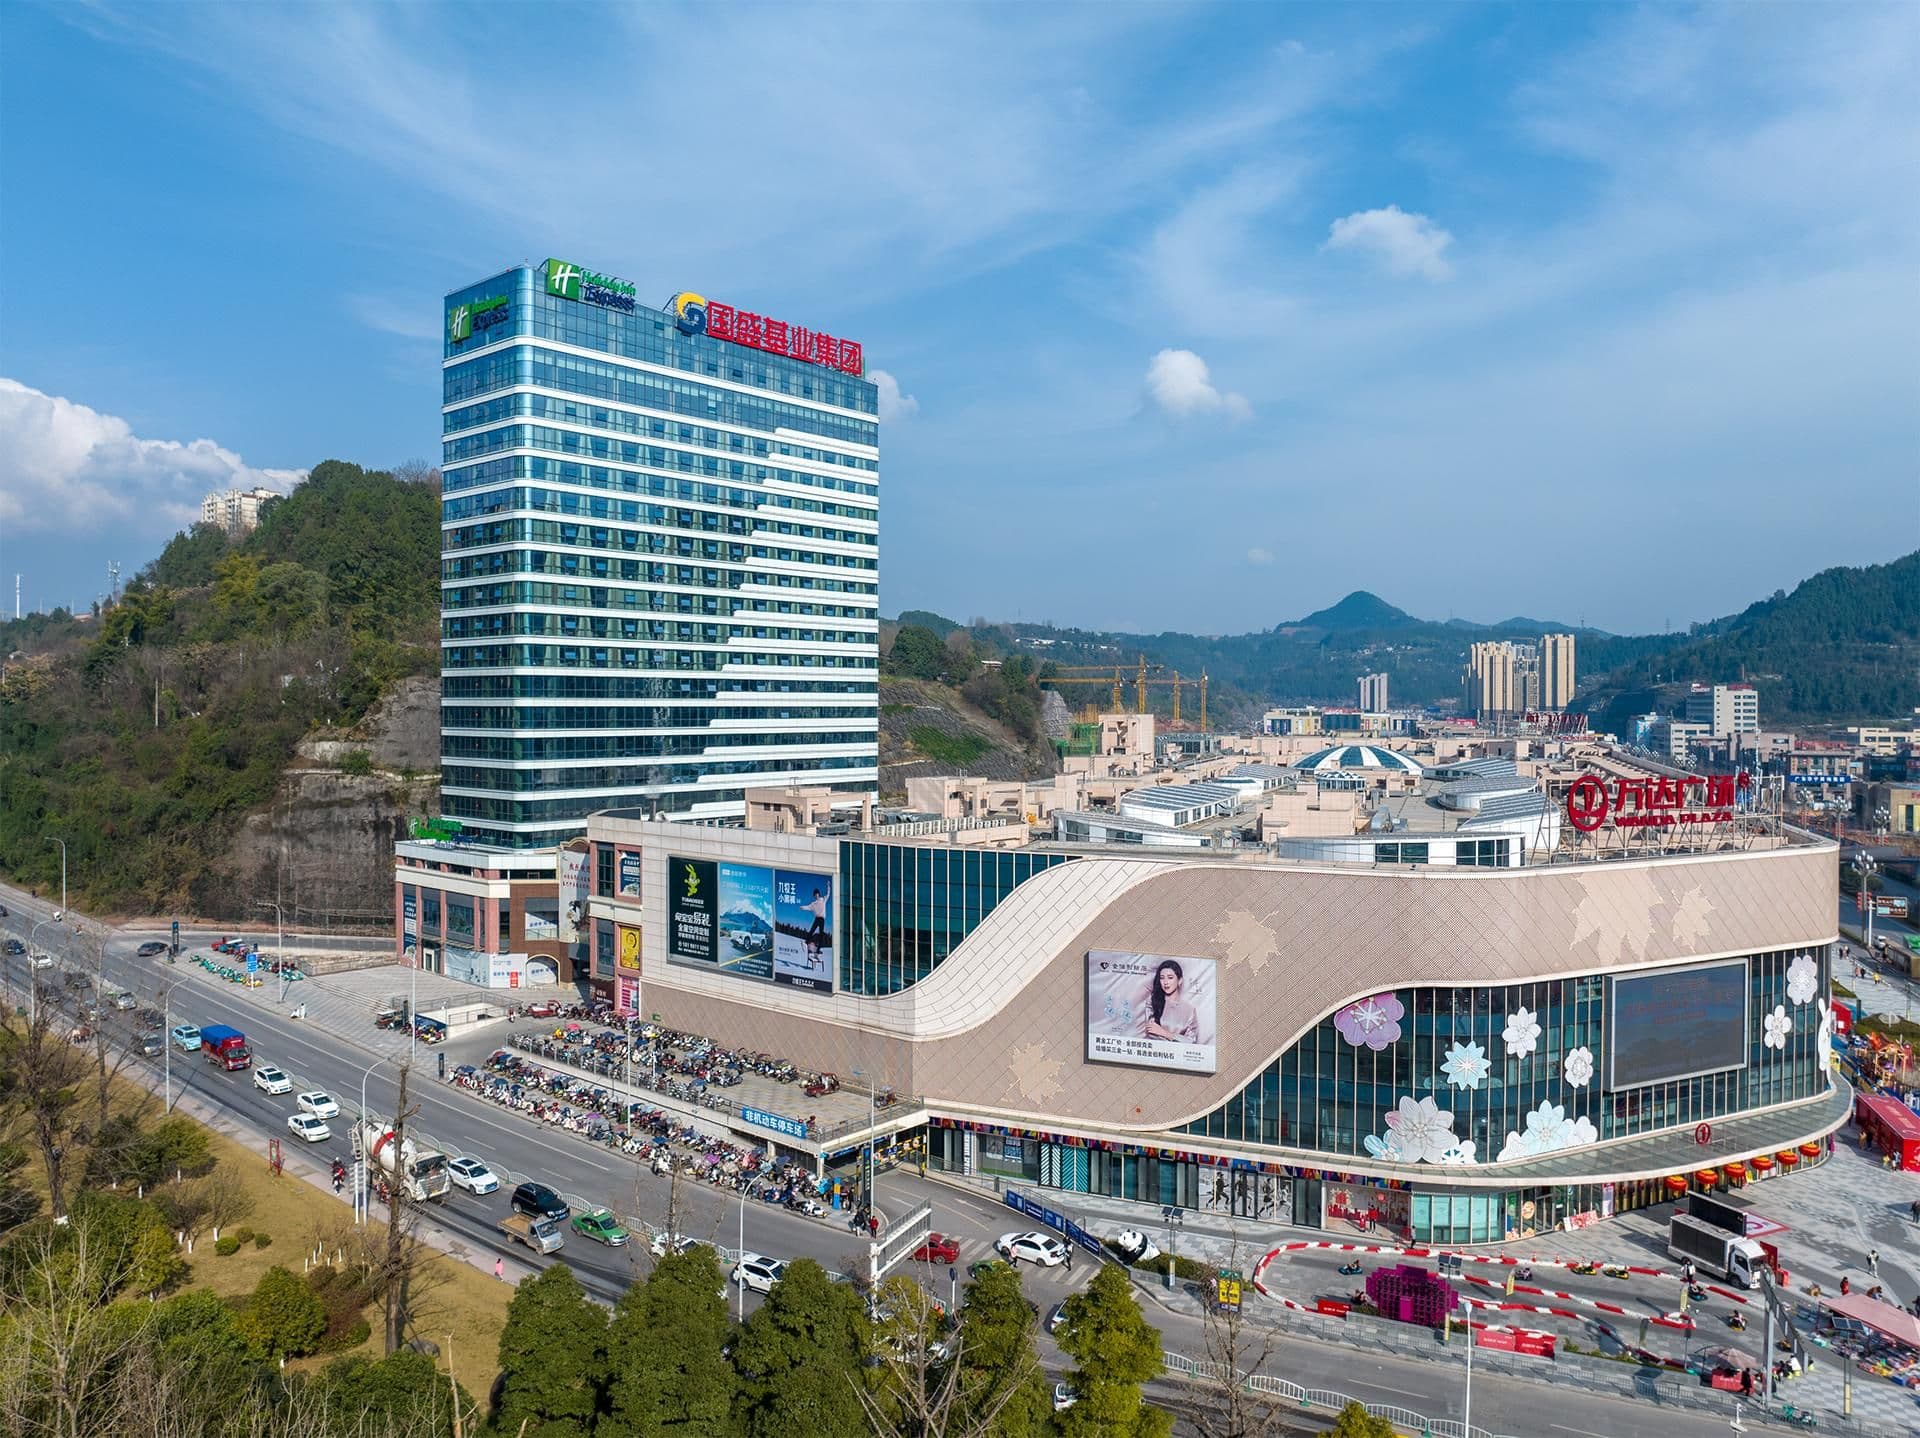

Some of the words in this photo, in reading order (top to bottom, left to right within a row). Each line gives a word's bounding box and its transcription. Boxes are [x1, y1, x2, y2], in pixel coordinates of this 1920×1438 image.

[582, 271, 619, 292] Holiday
[708, 301, 862, 377] 国盛基业集团
[1613, 776, 1735, 811] 万达广场
[1613, 814, 1677, 827] WANDA
[1679, 812, 1733, 824] PLAZA
[745, 1110, 802, 1137] 非机动车停车场
